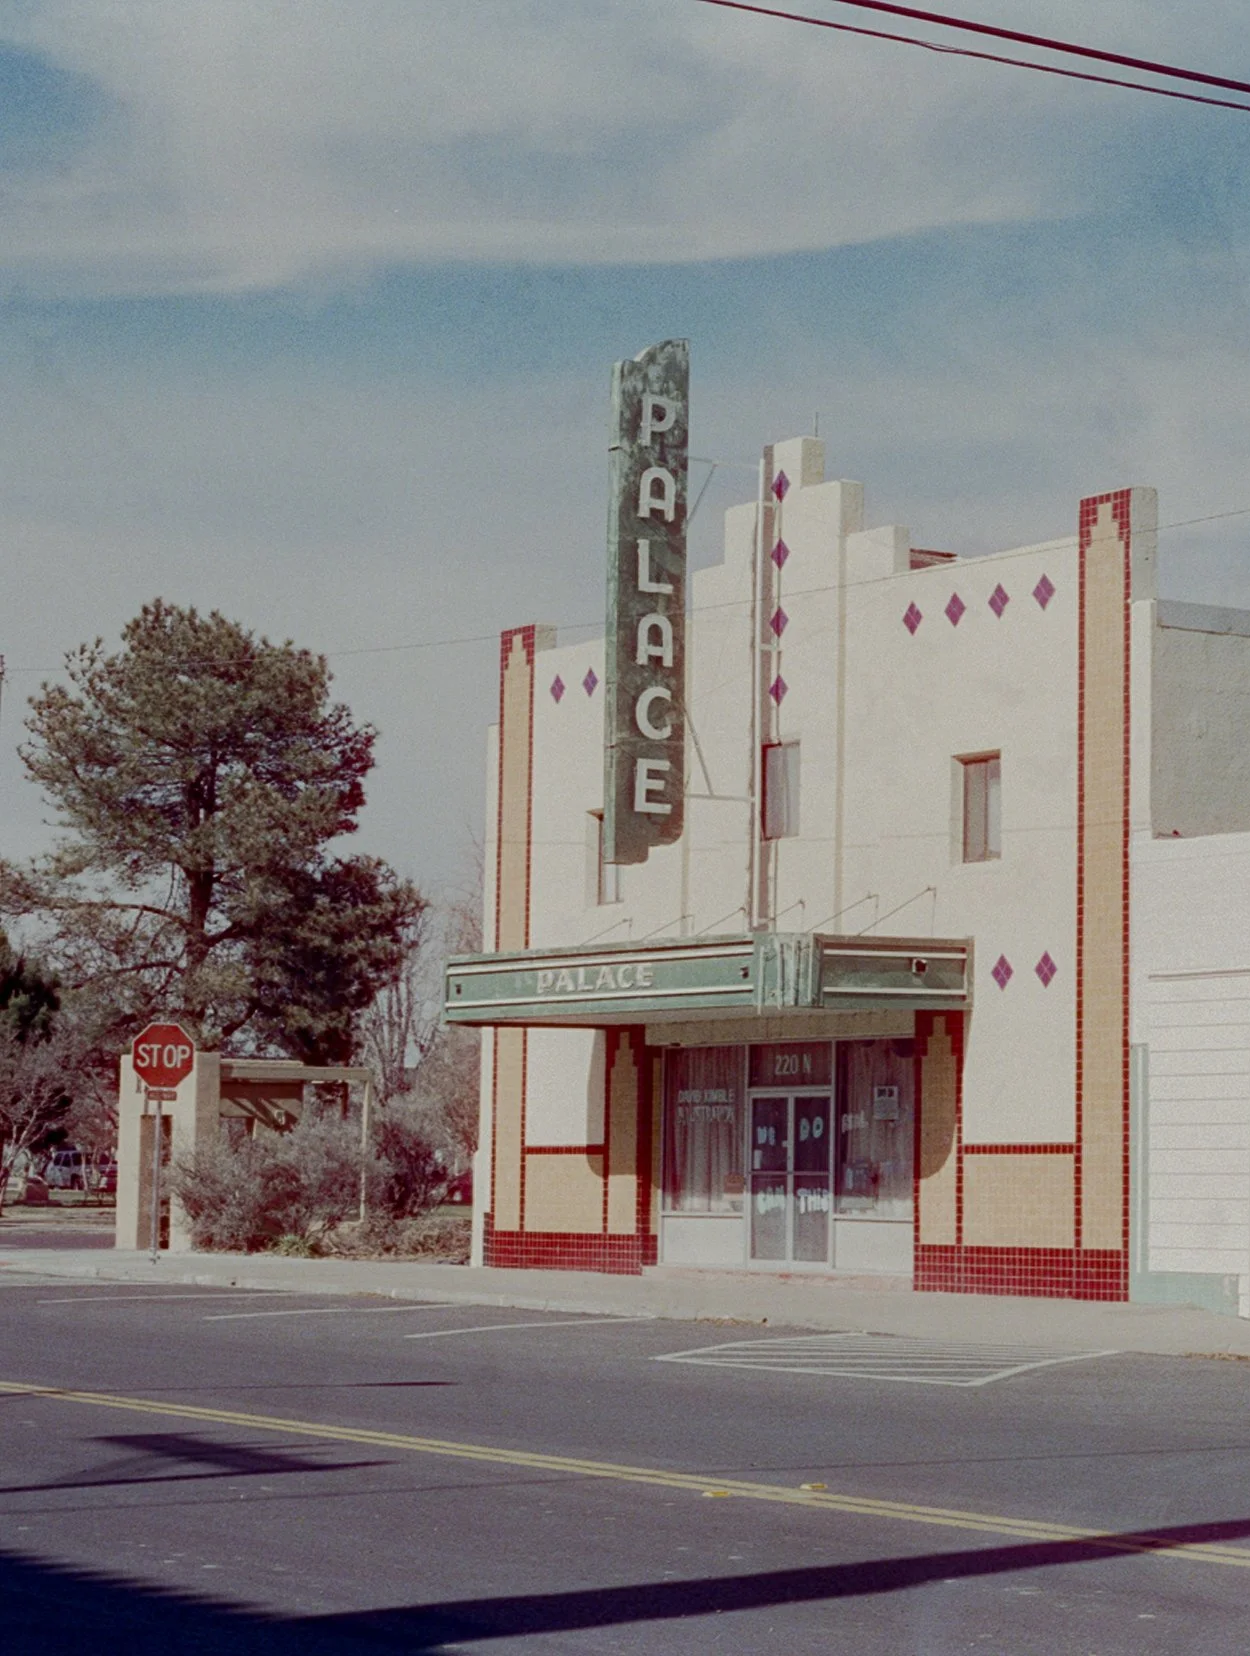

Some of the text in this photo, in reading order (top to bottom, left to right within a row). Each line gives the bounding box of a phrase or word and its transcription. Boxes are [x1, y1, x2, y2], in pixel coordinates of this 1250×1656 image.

[633, 392, 678, 816] PALACE
[535, 962, 655, 994] PALACE
[136, 1044, 190, 1068] STOP
[774, 1053, 813, 1075] 220 N
[799, 1116, 824, 1141] DO
